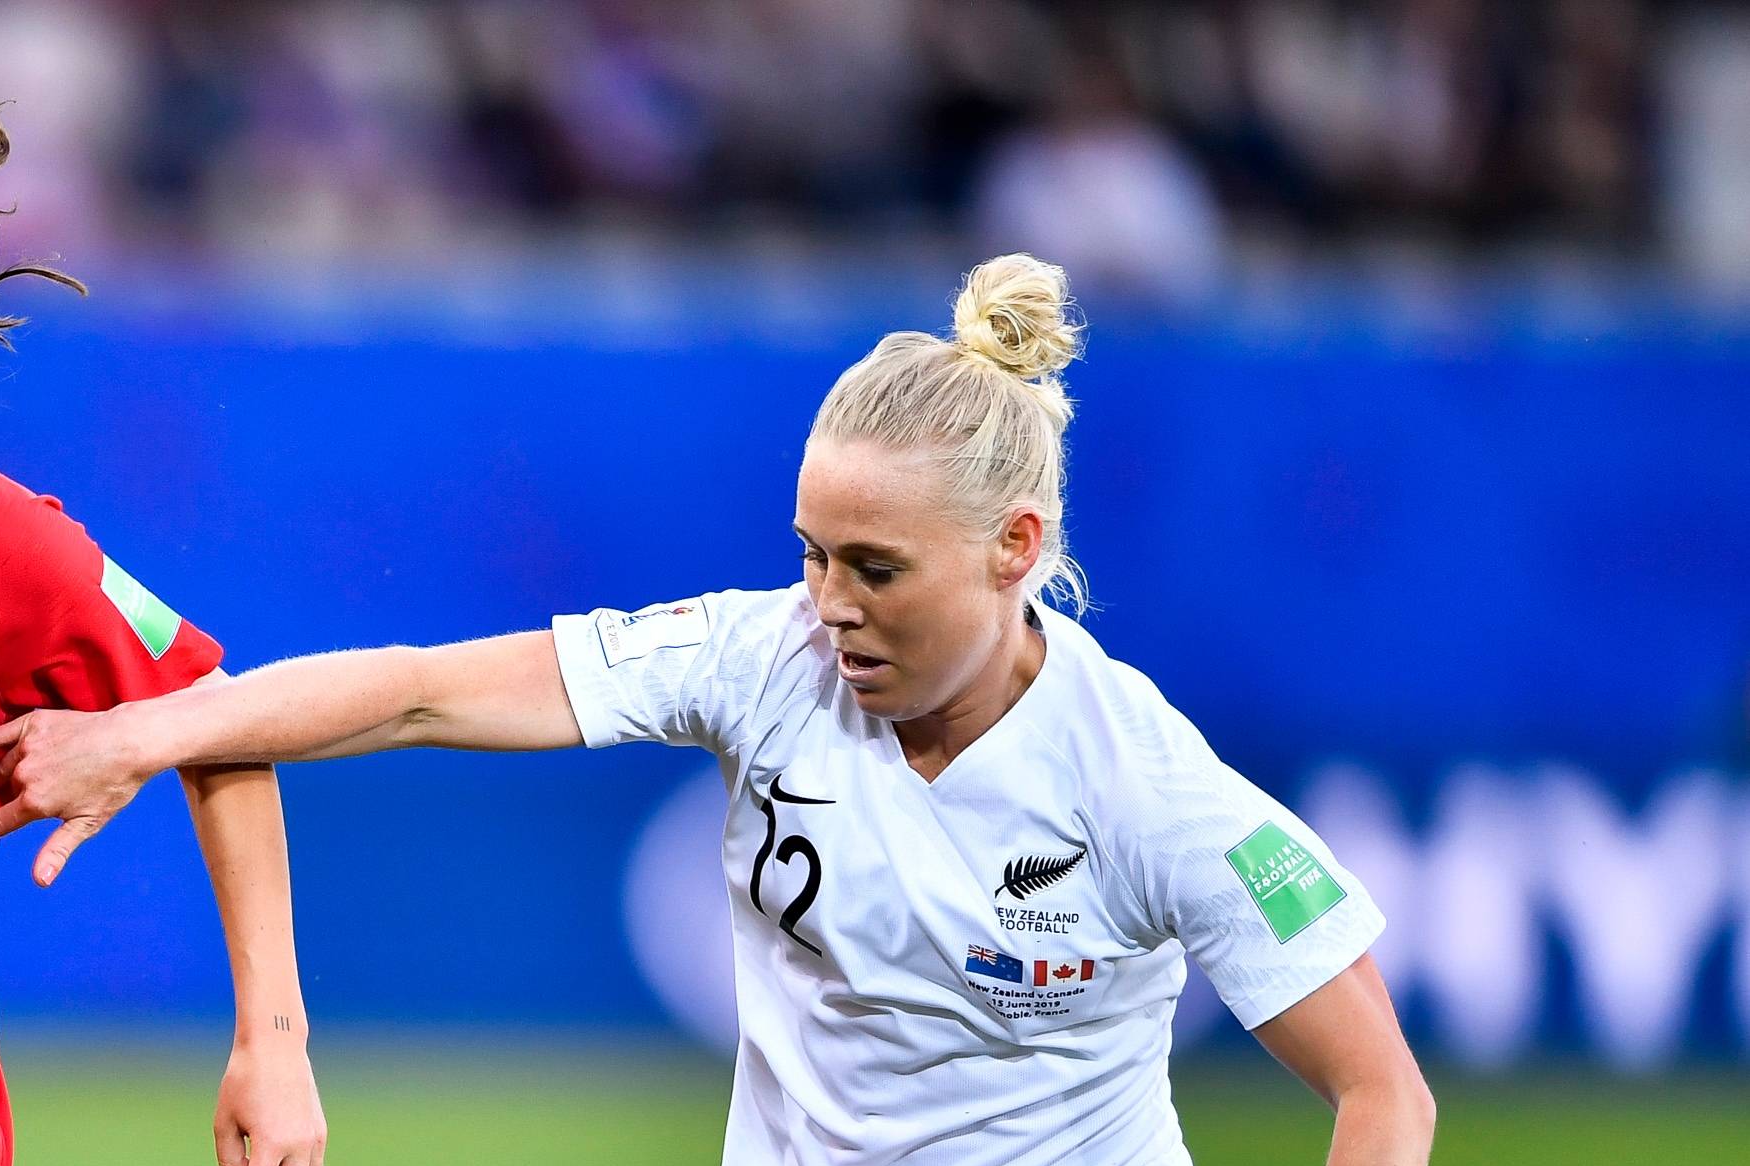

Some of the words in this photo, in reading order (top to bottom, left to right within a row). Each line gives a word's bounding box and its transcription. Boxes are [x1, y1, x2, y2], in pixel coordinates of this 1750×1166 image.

[1248, 840, 1299, 883] LIVING
[749, 799, 823, 959] 12
[1297, 865, 1324, 892] FIFA
[1019, 909, 1079, 924] ZEALAND
[1000, 918, 1069, 934] FOOTBALL
[968, 980, 990, 993] New
[992, 986, 1035, 999] Zealand
[1046, 987, 1085, 999] Canada
[991, 998, 1004, 1007] 15
[1006, 1000, 1031, 1009] June
[1033, 1000, 1061, 1008] 2019
[1034, 1008, 1070, 1016] France
